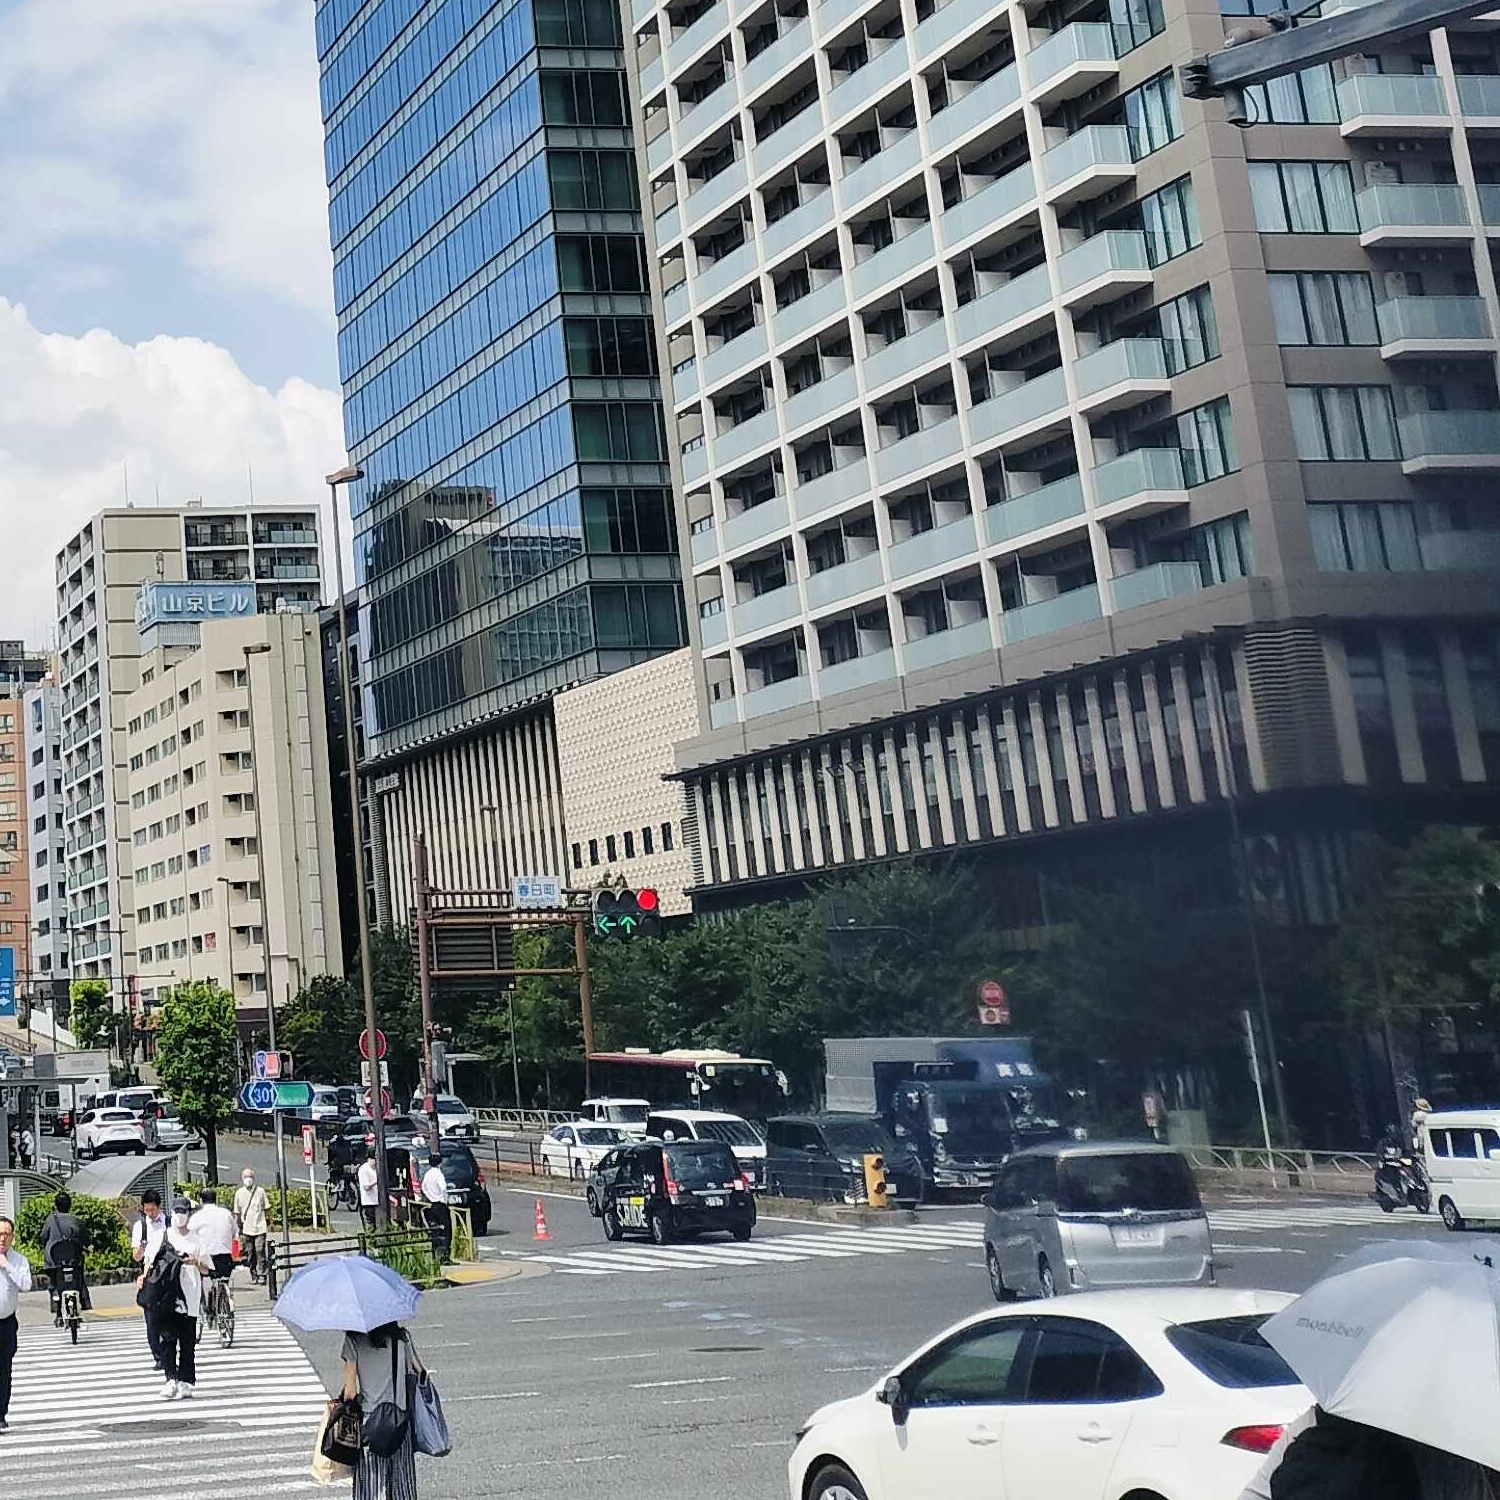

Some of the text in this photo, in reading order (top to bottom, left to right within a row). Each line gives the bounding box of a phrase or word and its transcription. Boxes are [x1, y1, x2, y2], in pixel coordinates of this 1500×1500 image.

[162, 591, 249, 612] 山京ビル
[518, 884, 555, 896] 春日町
[253, 1087, 275, 1103] 301
